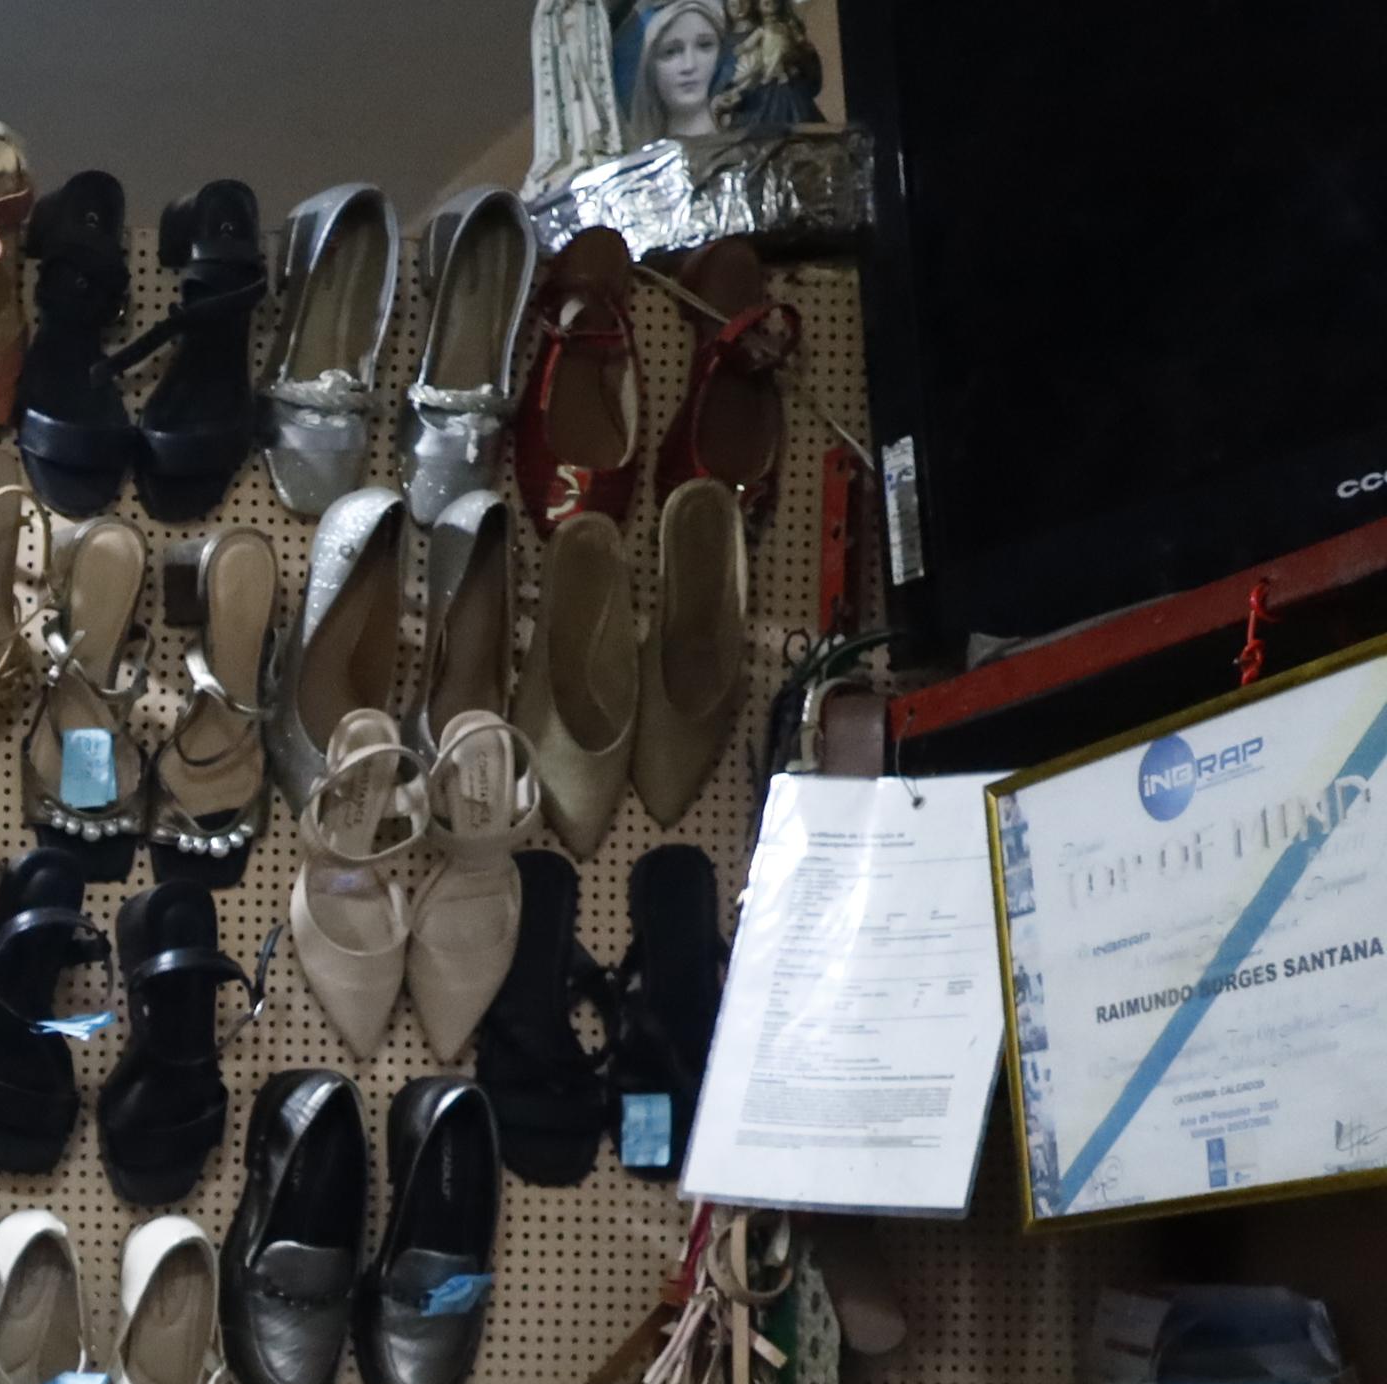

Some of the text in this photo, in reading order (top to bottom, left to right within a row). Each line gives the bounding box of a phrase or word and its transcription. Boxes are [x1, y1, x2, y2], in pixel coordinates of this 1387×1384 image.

[1095, 936, 1385, 1025] RAIMUNDO BORGES SANTANA
